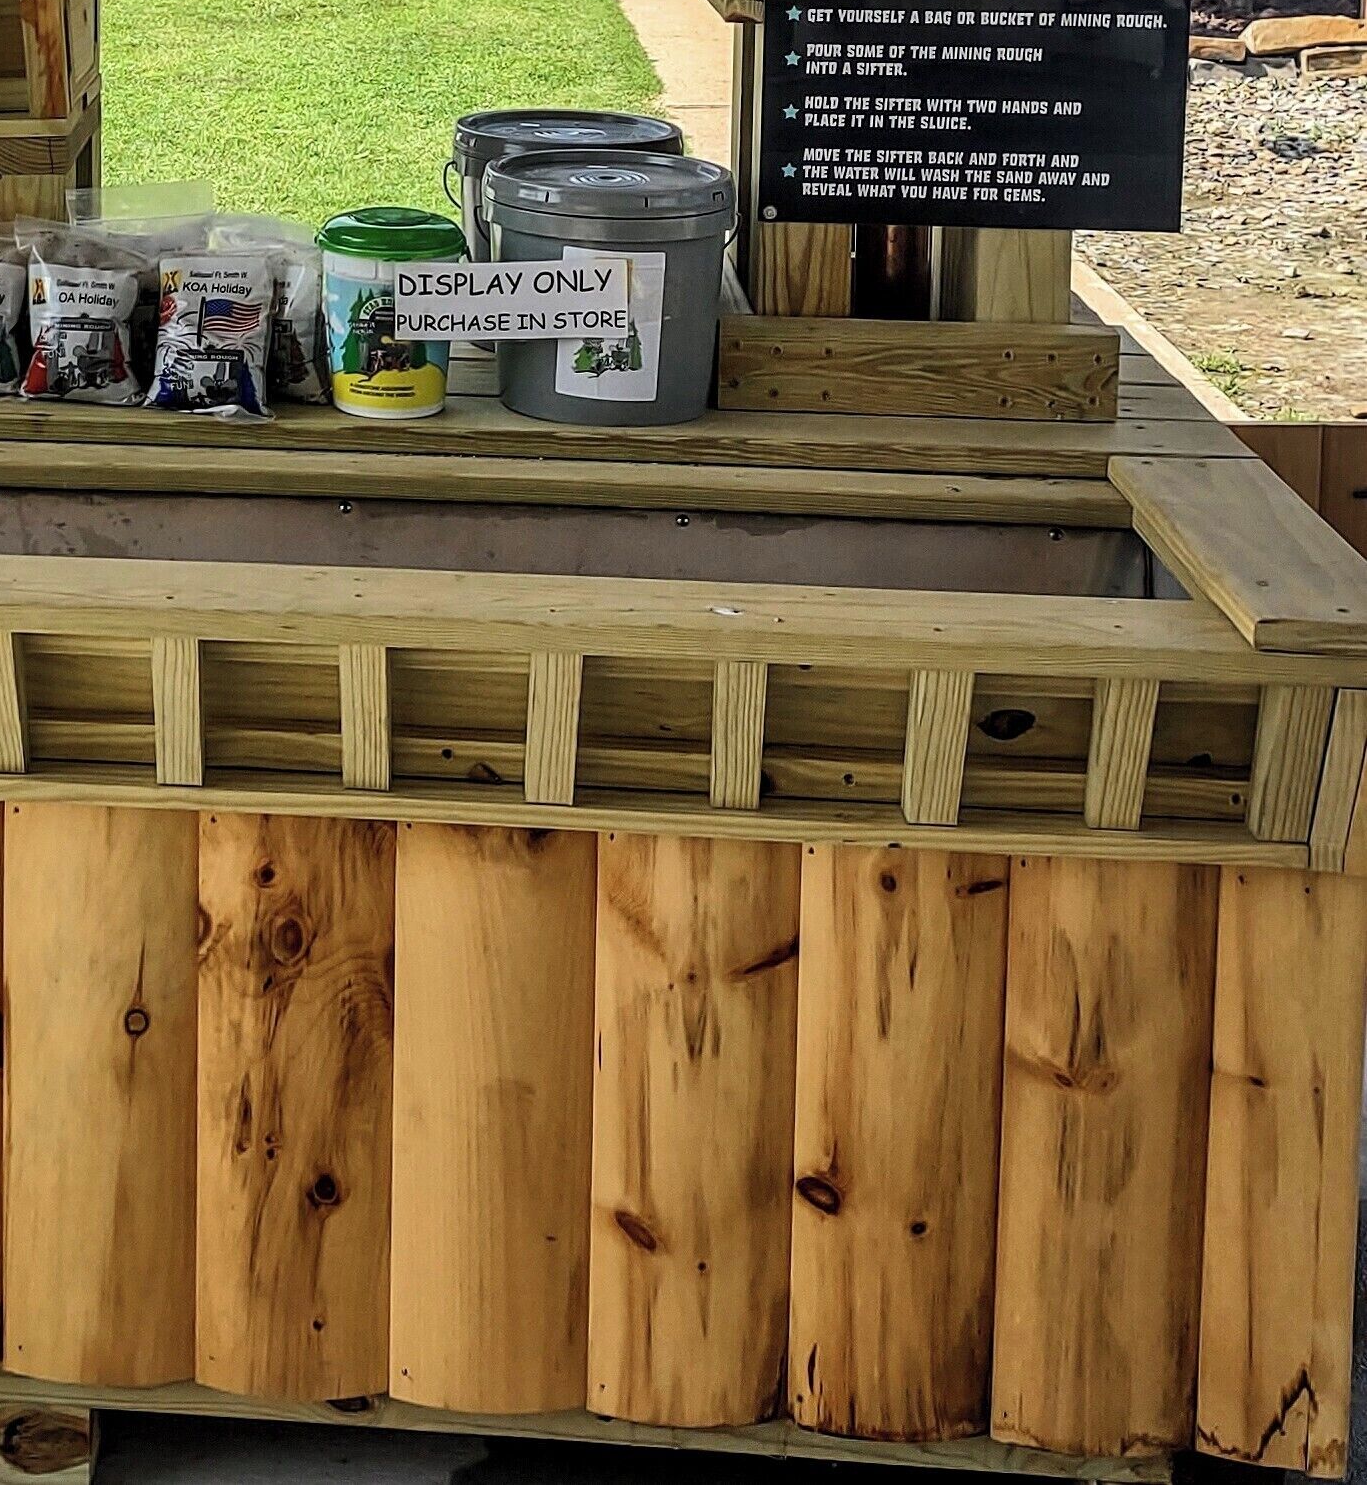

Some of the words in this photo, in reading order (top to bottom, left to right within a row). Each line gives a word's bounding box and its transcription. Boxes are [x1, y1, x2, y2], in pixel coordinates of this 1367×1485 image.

[807, 9, 833, 23] GET
[838, 9, 905, 24] YOURSELF
[910, 11, 920, 24] A
[924, 11, 952, 25] BAG
[957, 11, 976, 25] OR
[980, 12, 1034, 26] BUCKET
[1038, 13, 1056, 27] OF
[1060, 13, 1111, 28] MINING
[1116, 14, 1168, 29] ROUGH.
[806, 43, 842, 57] POUR
[847, 44, 884, 58] SOME
[889, 45, 906, 59] OF
[910, 46, 937, 60] THE
[942, 46, 992, 61] MINING
[997, 47, 1043, 62] ROUGH
[805, 61, 837, 75] INTO
[842, 62, 852, 75] A
[856, 62, 908, 76] SIFTER.
[804, 96, 839, 110] HOLD
[844, 96, 871, 110] THE
[875, 97, 922, 111] SIFTER
[927, 98, 962, 112] WITH
[967, 99, 997, 113] TWO
[1001, 100, 1048, 114] HANDS
[1053, 101, 1082, 115] AND
[804, 113, 846, 127] PLACE
[851, 114, 864, 128] IT
[869, 114, 884, 128] IN
[889, 115, 916, 129] THE
[920, 116, 972, 130] SLUICE.
[803, 148, 841, 162] MOVE
[845, 148, 872, 162] THE
[876, 150, 923, 164] SIFTER
[928, 151, 964, 165] BACK
[968, 152, 997, 166] AND
[1002, 153, 1046, 167] FORTH
[1051, 154, 1080, 168] AND
[802, 165, 829, 179] THE
[834, 166, 879, 180] WATER
[884, 167, 916, 181] WILL
[921, 168, 960, 182] WASH
[965, 170, 992, 183] THE
[996, 170, 1034, 184] SAND
[1038, 171, 1077, 186] AWAY
[1081, 172, 1110, 186] AND
[802, 182, 852, 197] REVEAL
[857, 184, 896, 198] WHAT
[901, 185, 928, 199] YOU
[932, 186, 968, 200] HAVE
[973, 187, 998, 201] FOR
[1003, 188, 1046, 202] GEMS.
[182, 282, 208, 293] KOA
[211, 283, 252, 298] Holiday
[398, 272, 523, 296] DISPLAY
[533, 268, 612, 294] ONLY
[78, 293, 119, 309] Holiday
[396, 313, 510, 332] PURCHASE
[517, 313, 546, 330] IN
[553, 309, 627, 329] STORE
